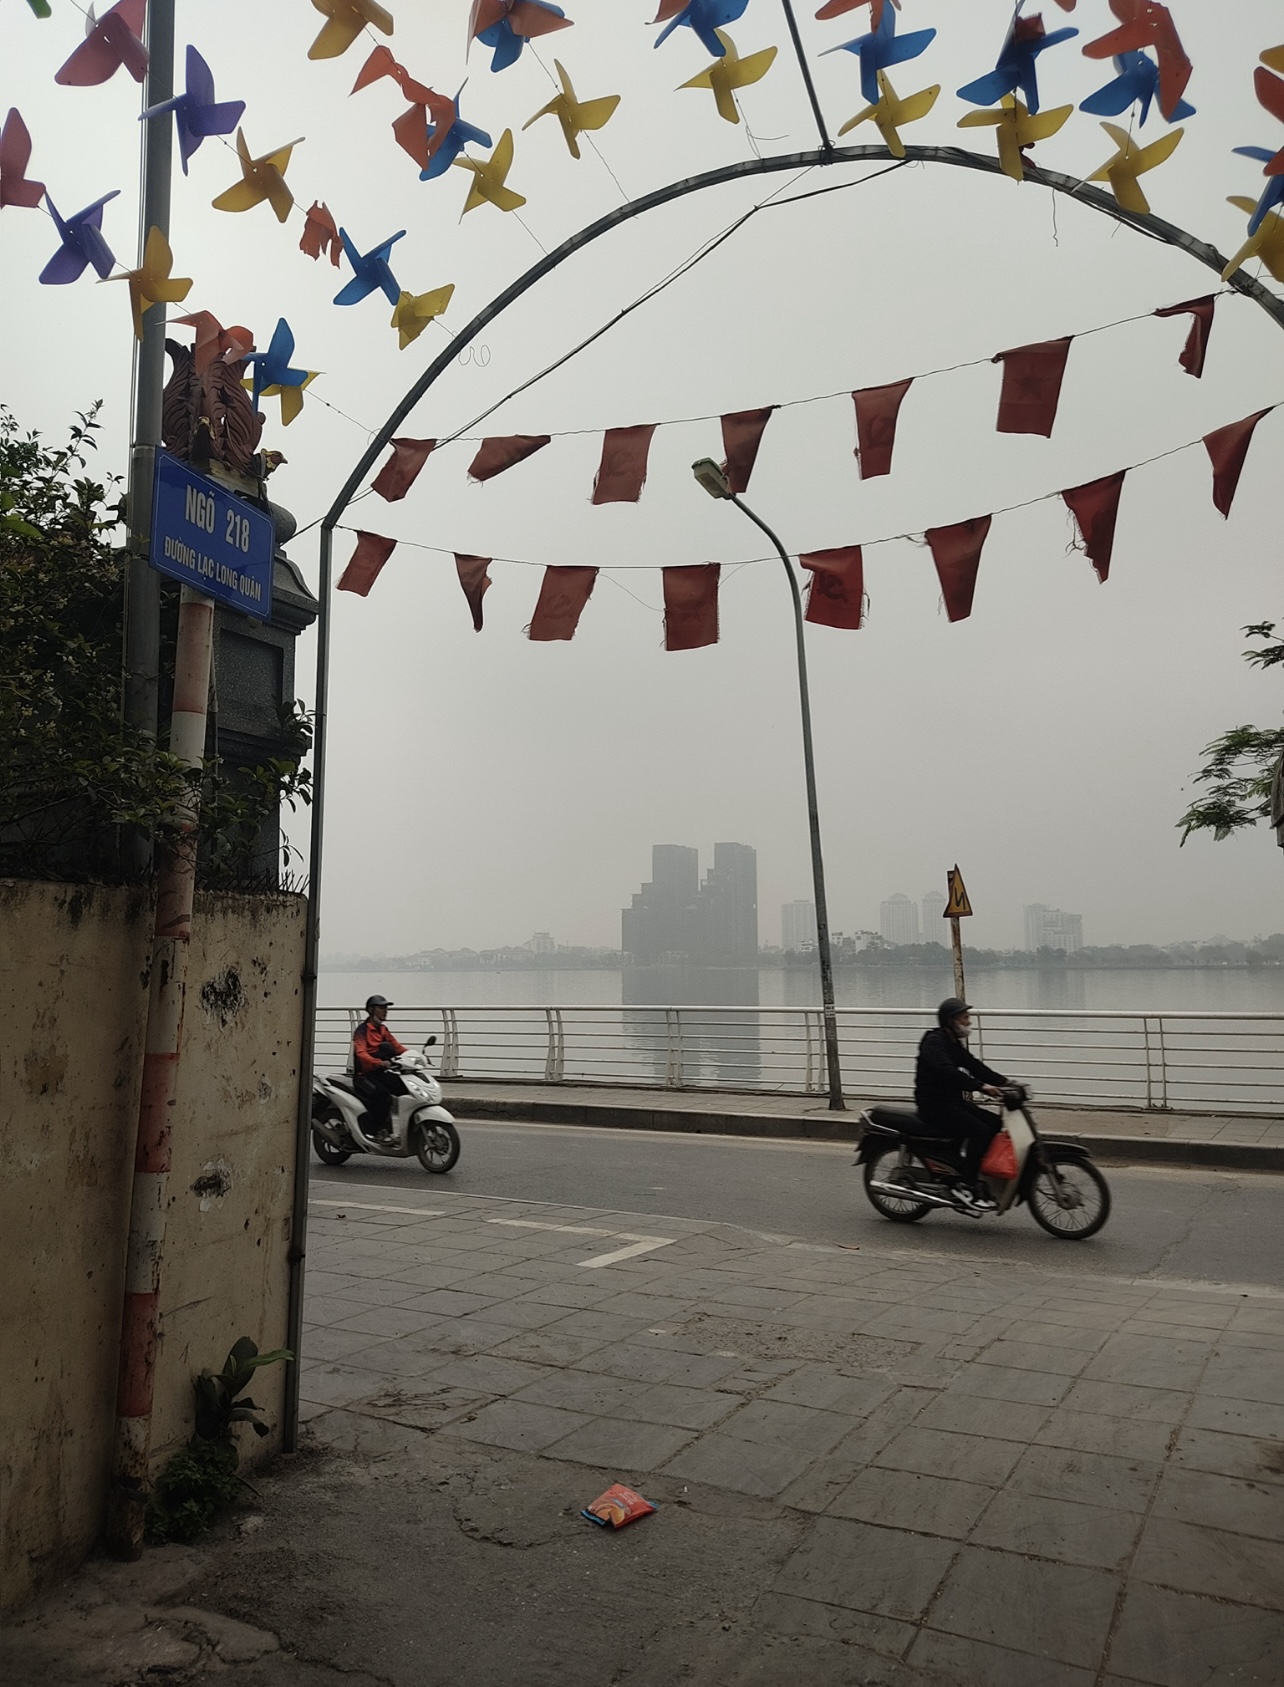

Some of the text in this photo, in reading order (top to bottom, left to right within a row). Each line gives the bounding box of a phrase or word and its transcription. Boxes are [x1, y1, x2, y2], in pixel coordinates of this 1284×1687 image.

[185, 485, 250, 552] NGÕ 218
[165, 535, 261, 602] ĐƯỜNG LẠC LONG QUÂN
